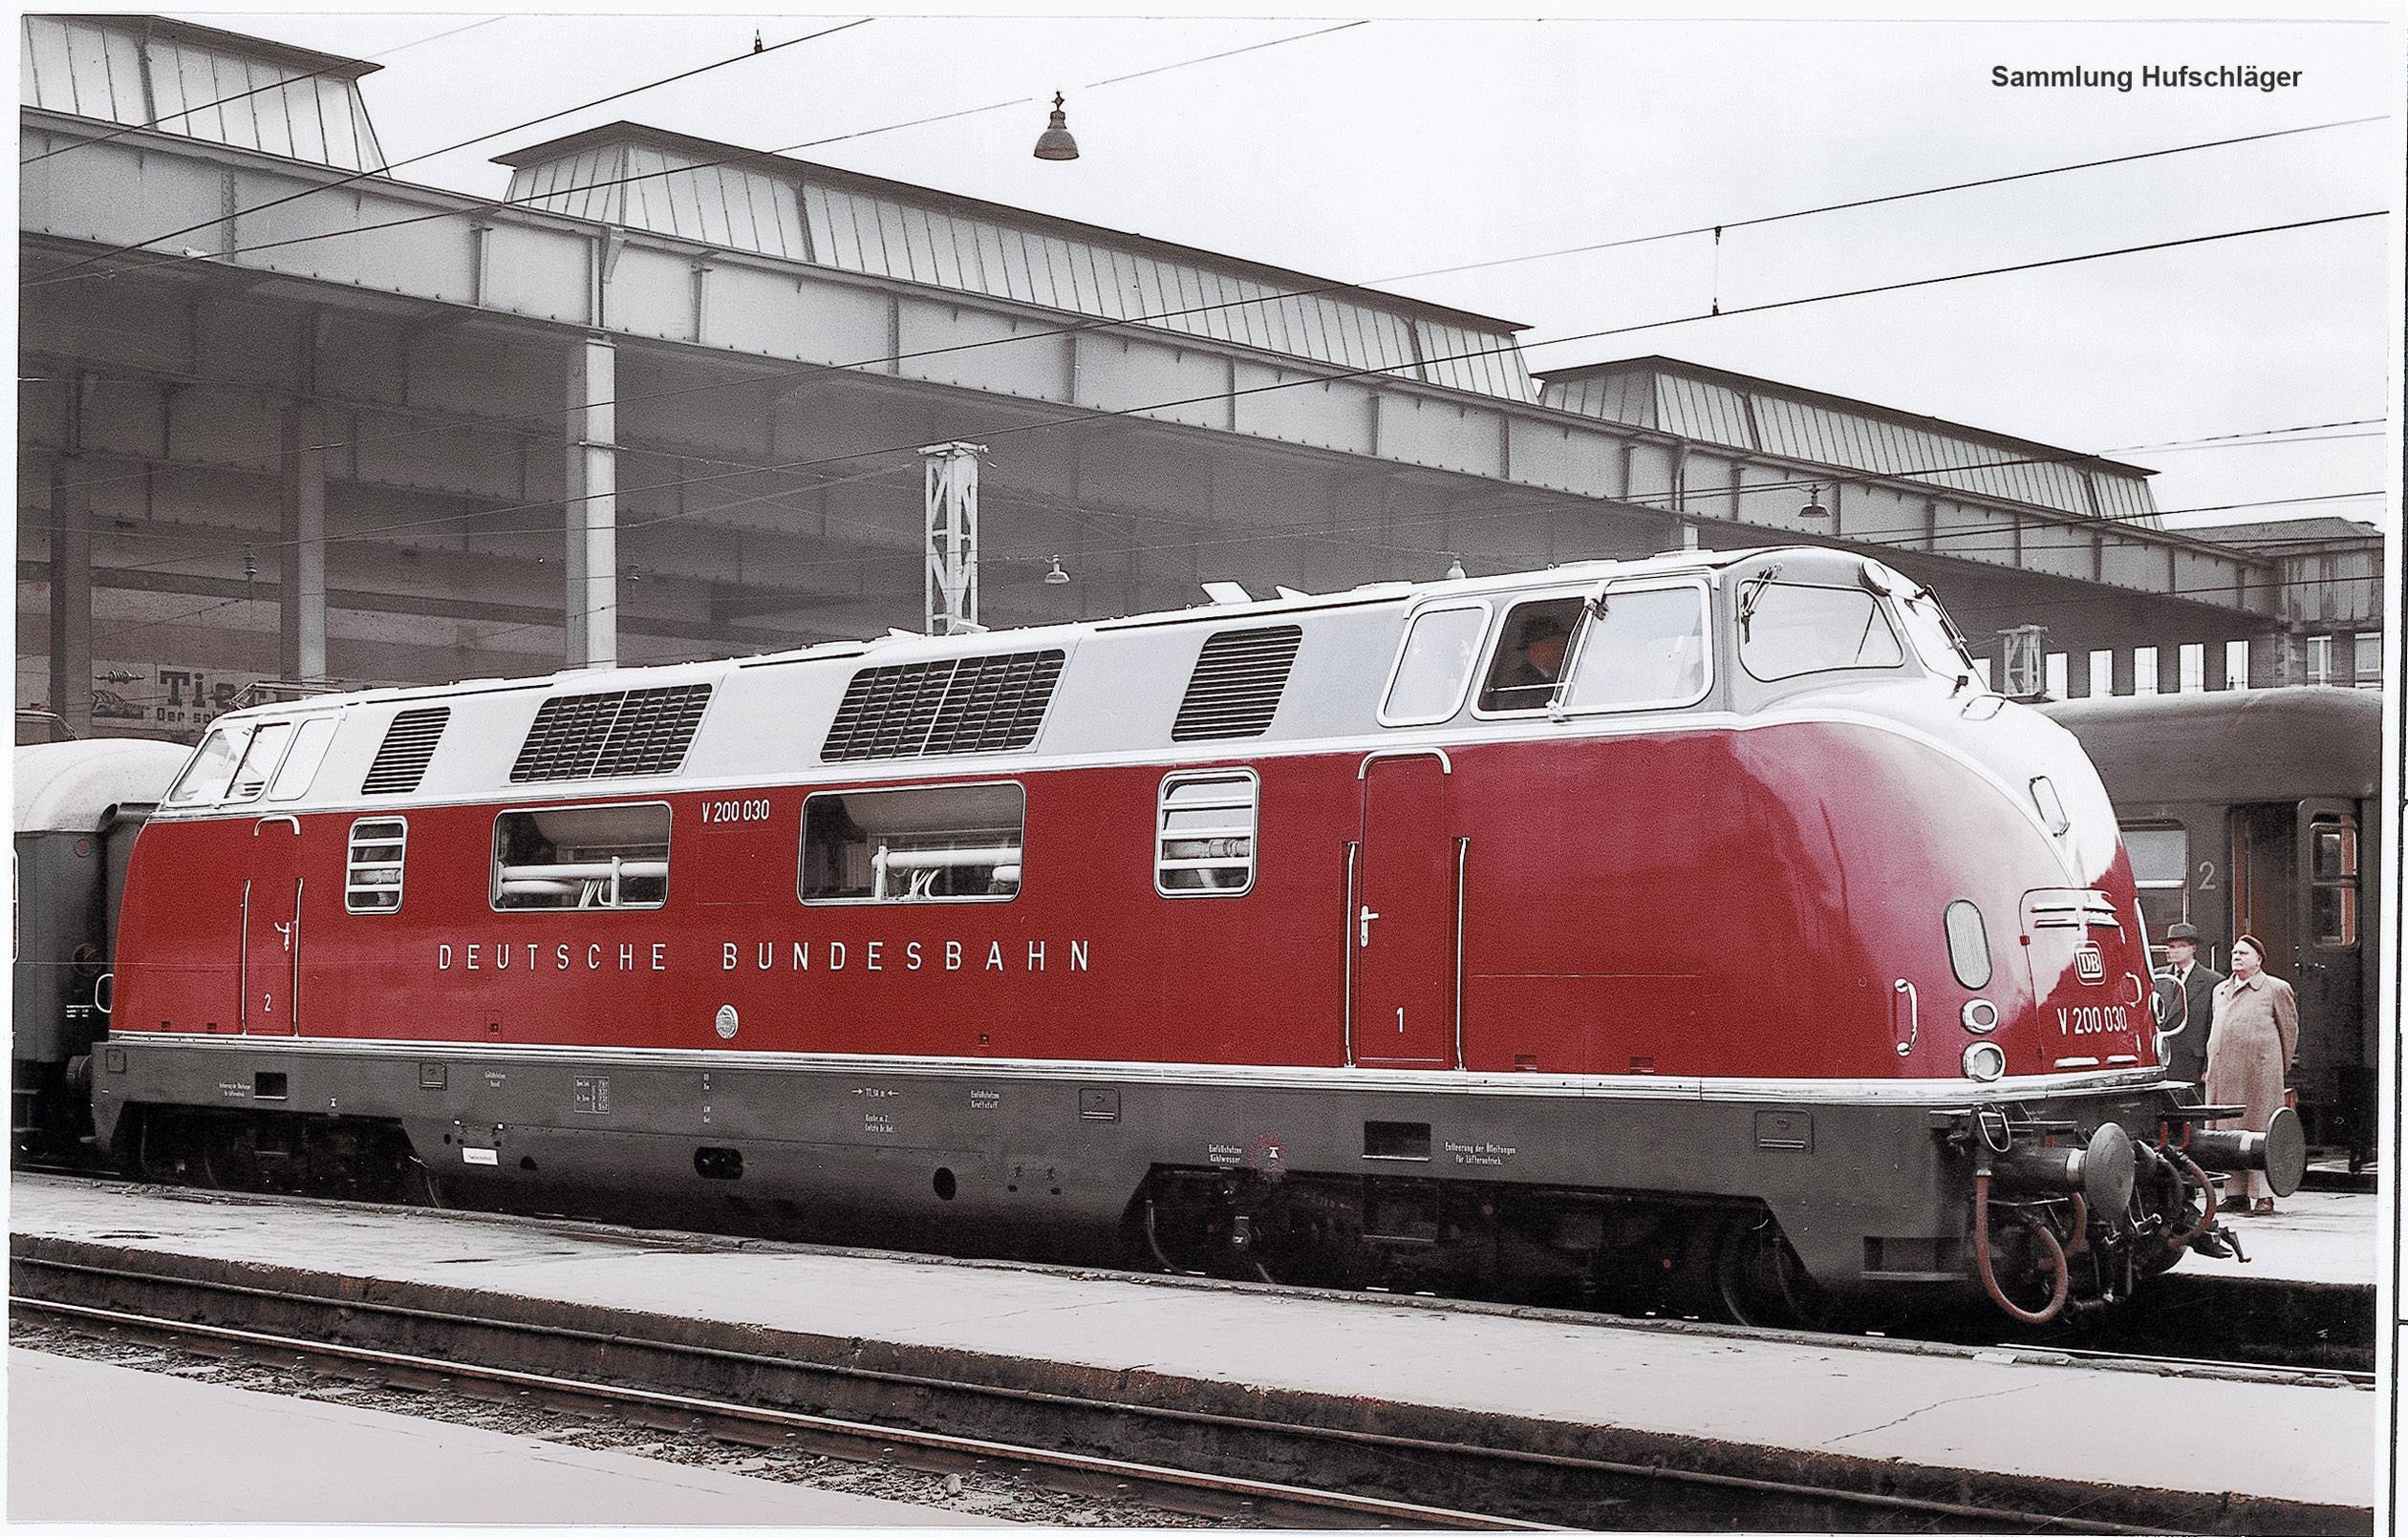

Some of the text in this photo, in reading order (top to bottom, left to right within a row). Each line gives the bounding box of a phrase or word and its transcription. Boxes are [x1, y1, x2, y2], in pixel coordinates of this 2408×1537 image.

[702, 799, 770, 822] V 200 030
[2198, 861, 2217, 890] 2
[439, 940, 1088, 971] DEUTSCHE BUNDESBAHN
[264, 993, 272, 1013] 2
[1396, 1007, 1405, 1034] 1
[2056, 1005, 2127, 1035] V 200 030
